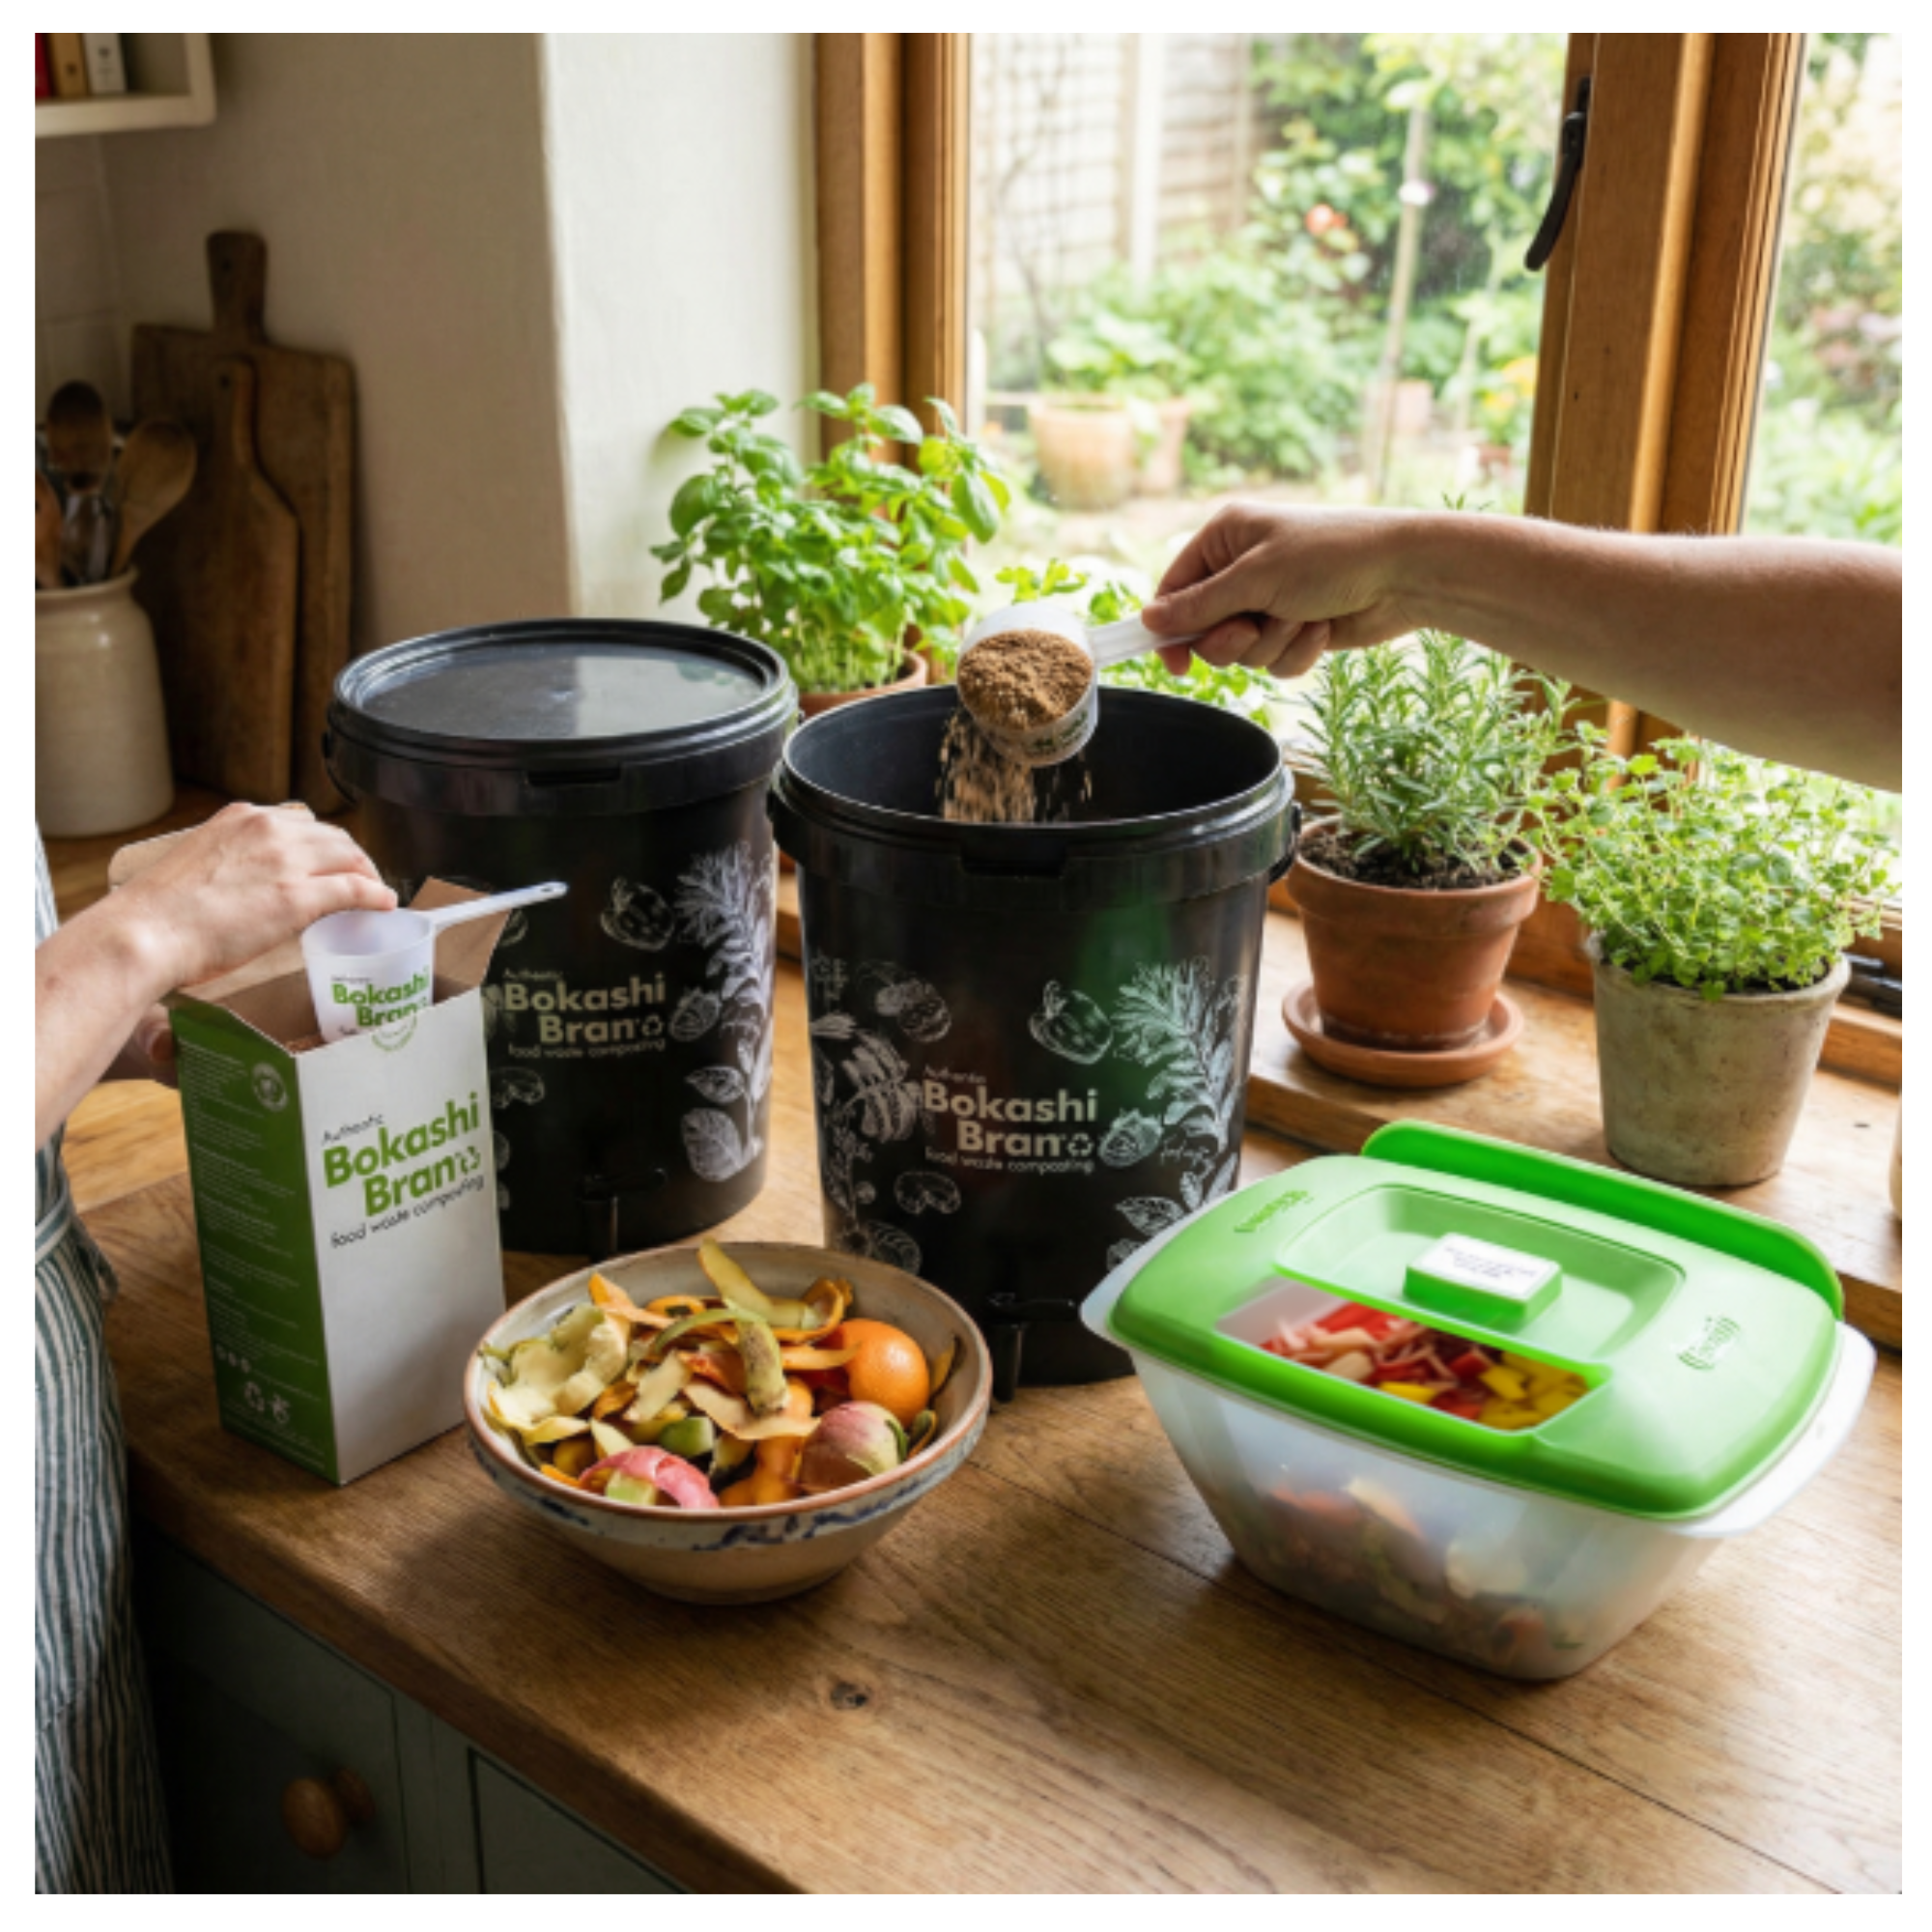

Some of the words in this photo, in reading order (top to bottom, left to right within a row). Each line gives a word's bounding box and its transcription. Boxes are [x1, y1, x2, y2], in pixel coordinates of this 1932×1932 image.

[331, 967, 429, 1005] Bokashi
[504, 972, 665, 1011] Bokashi
[539, 1015, 635, 1043] Bran
[923, 1078, 1098, 1122] Bokashi
[324, 1092, 479, 1188] Bokashi
[956, 1119, 1061, 1157] Bran
[1008, 1156, 1095, 1176] composting
[364, 1155, 455, 1217] Bran
[331, 1223, 367, 1247] food
[413, 1175, 484, 1217] composting
